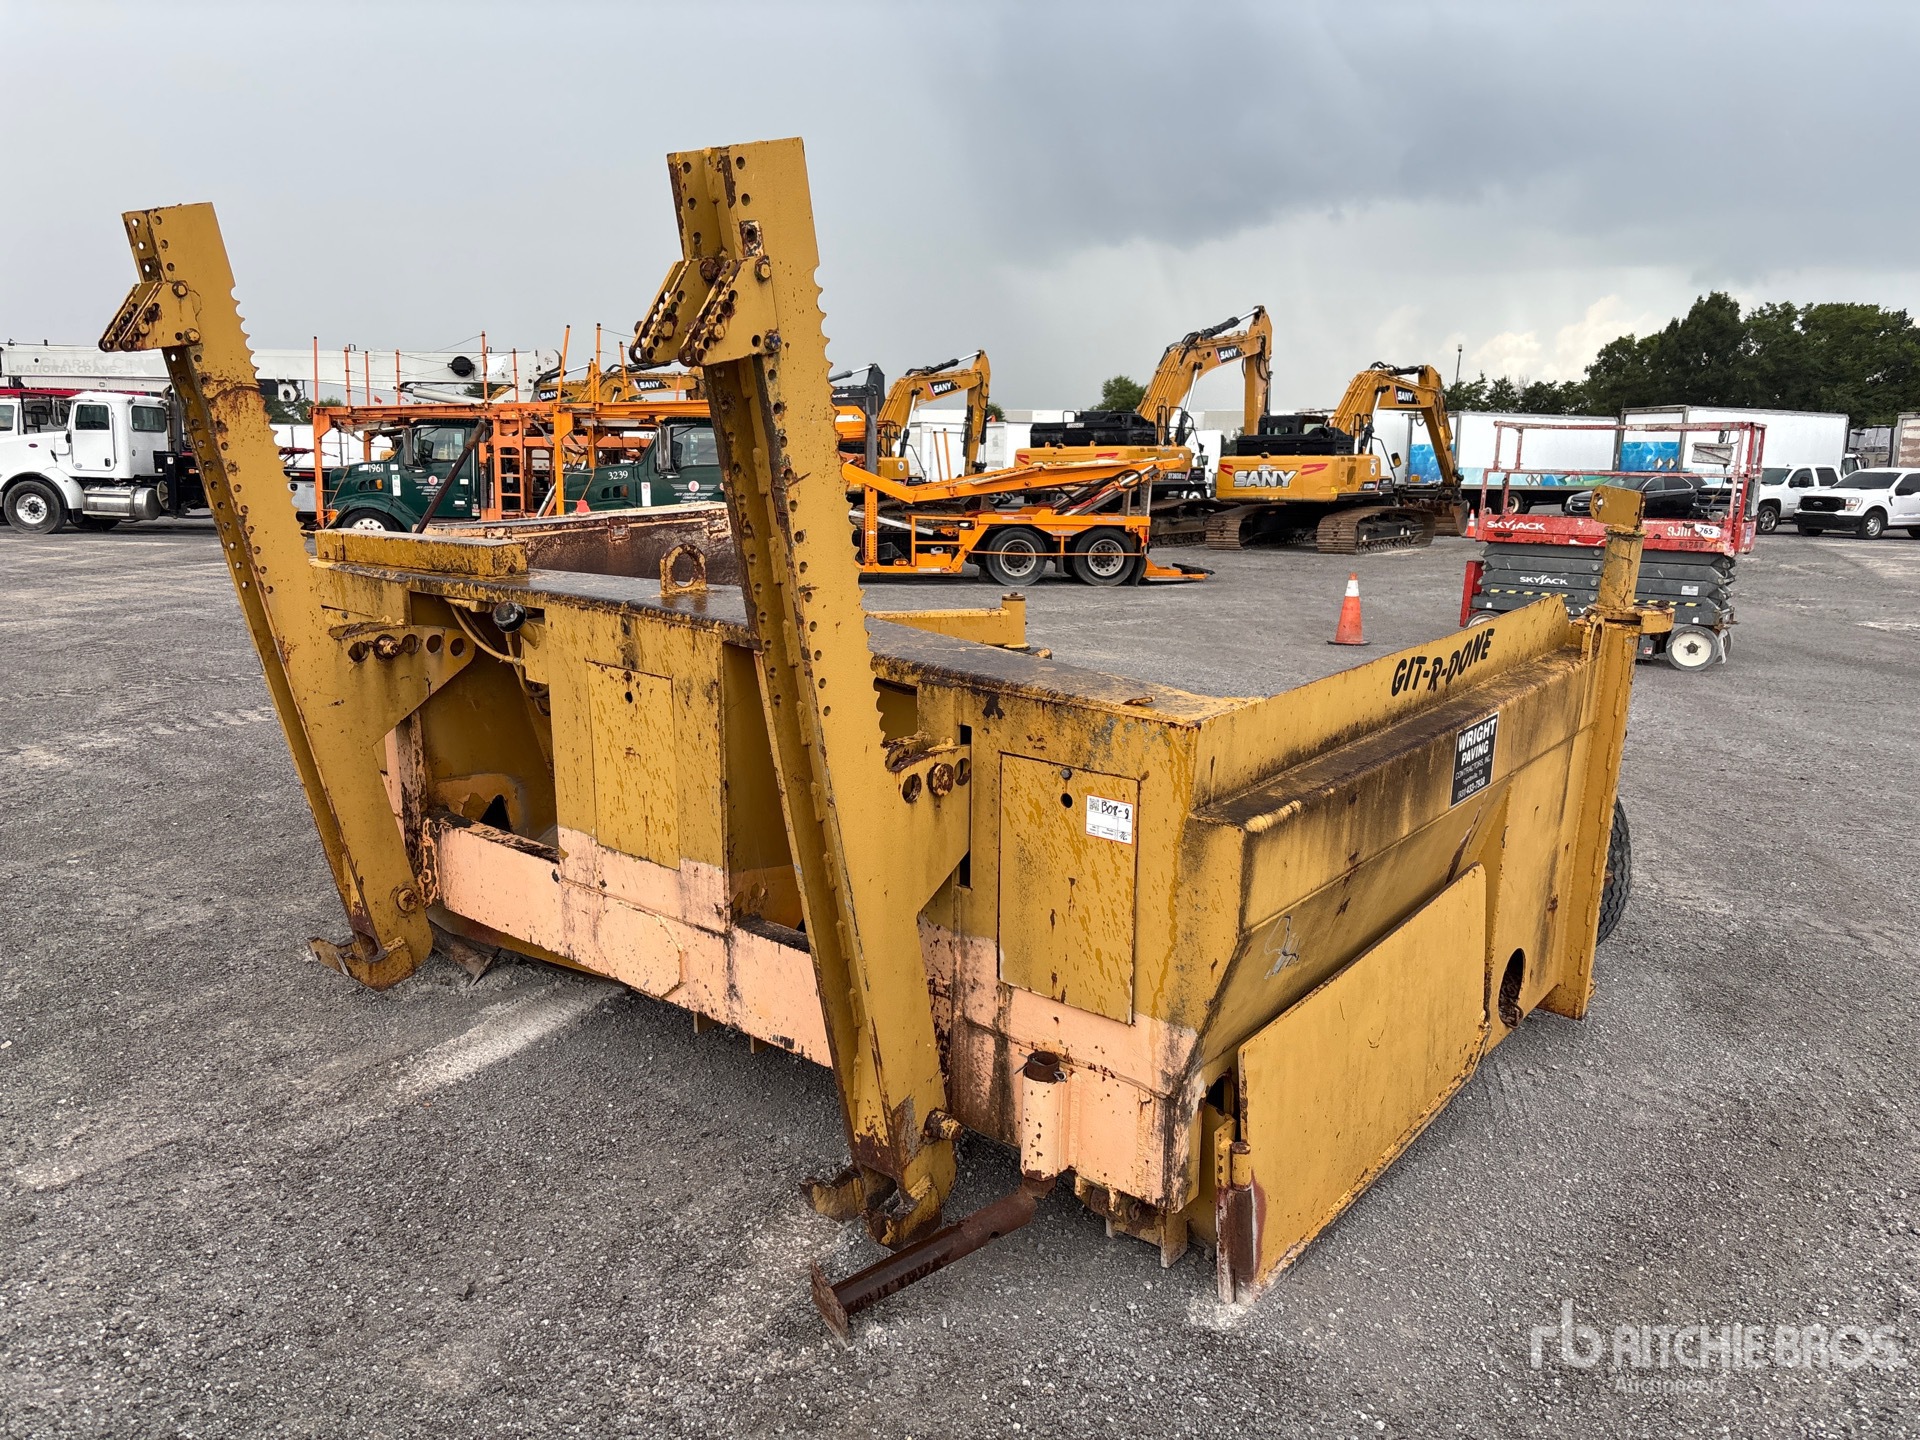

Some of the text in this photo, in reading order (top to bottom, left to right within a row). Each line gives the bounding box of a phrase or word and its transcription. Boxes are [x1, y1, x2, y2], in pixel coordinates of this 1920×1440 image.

[1218, 348, 1237, 361] SANY
[639, 380, 659, 388] SANY
[933, 383, 951, 392] SANY
[1396, 390, 1413, 401] SANY
[368, 463, 383, 473] 1961
[607, 470, 629, 480] 3239
[1233, 470, 1297, 488] SANY
[1486, 517, 1547, 533] SKYJACK
[1519, 574, 1569, 586] SKYJACK
[1391, 628, 1495, 697] GIT-R-DONE
[1459, 718, 1497, 752] WRIGHT
[1461, 740, 1489, 767] PAVING
